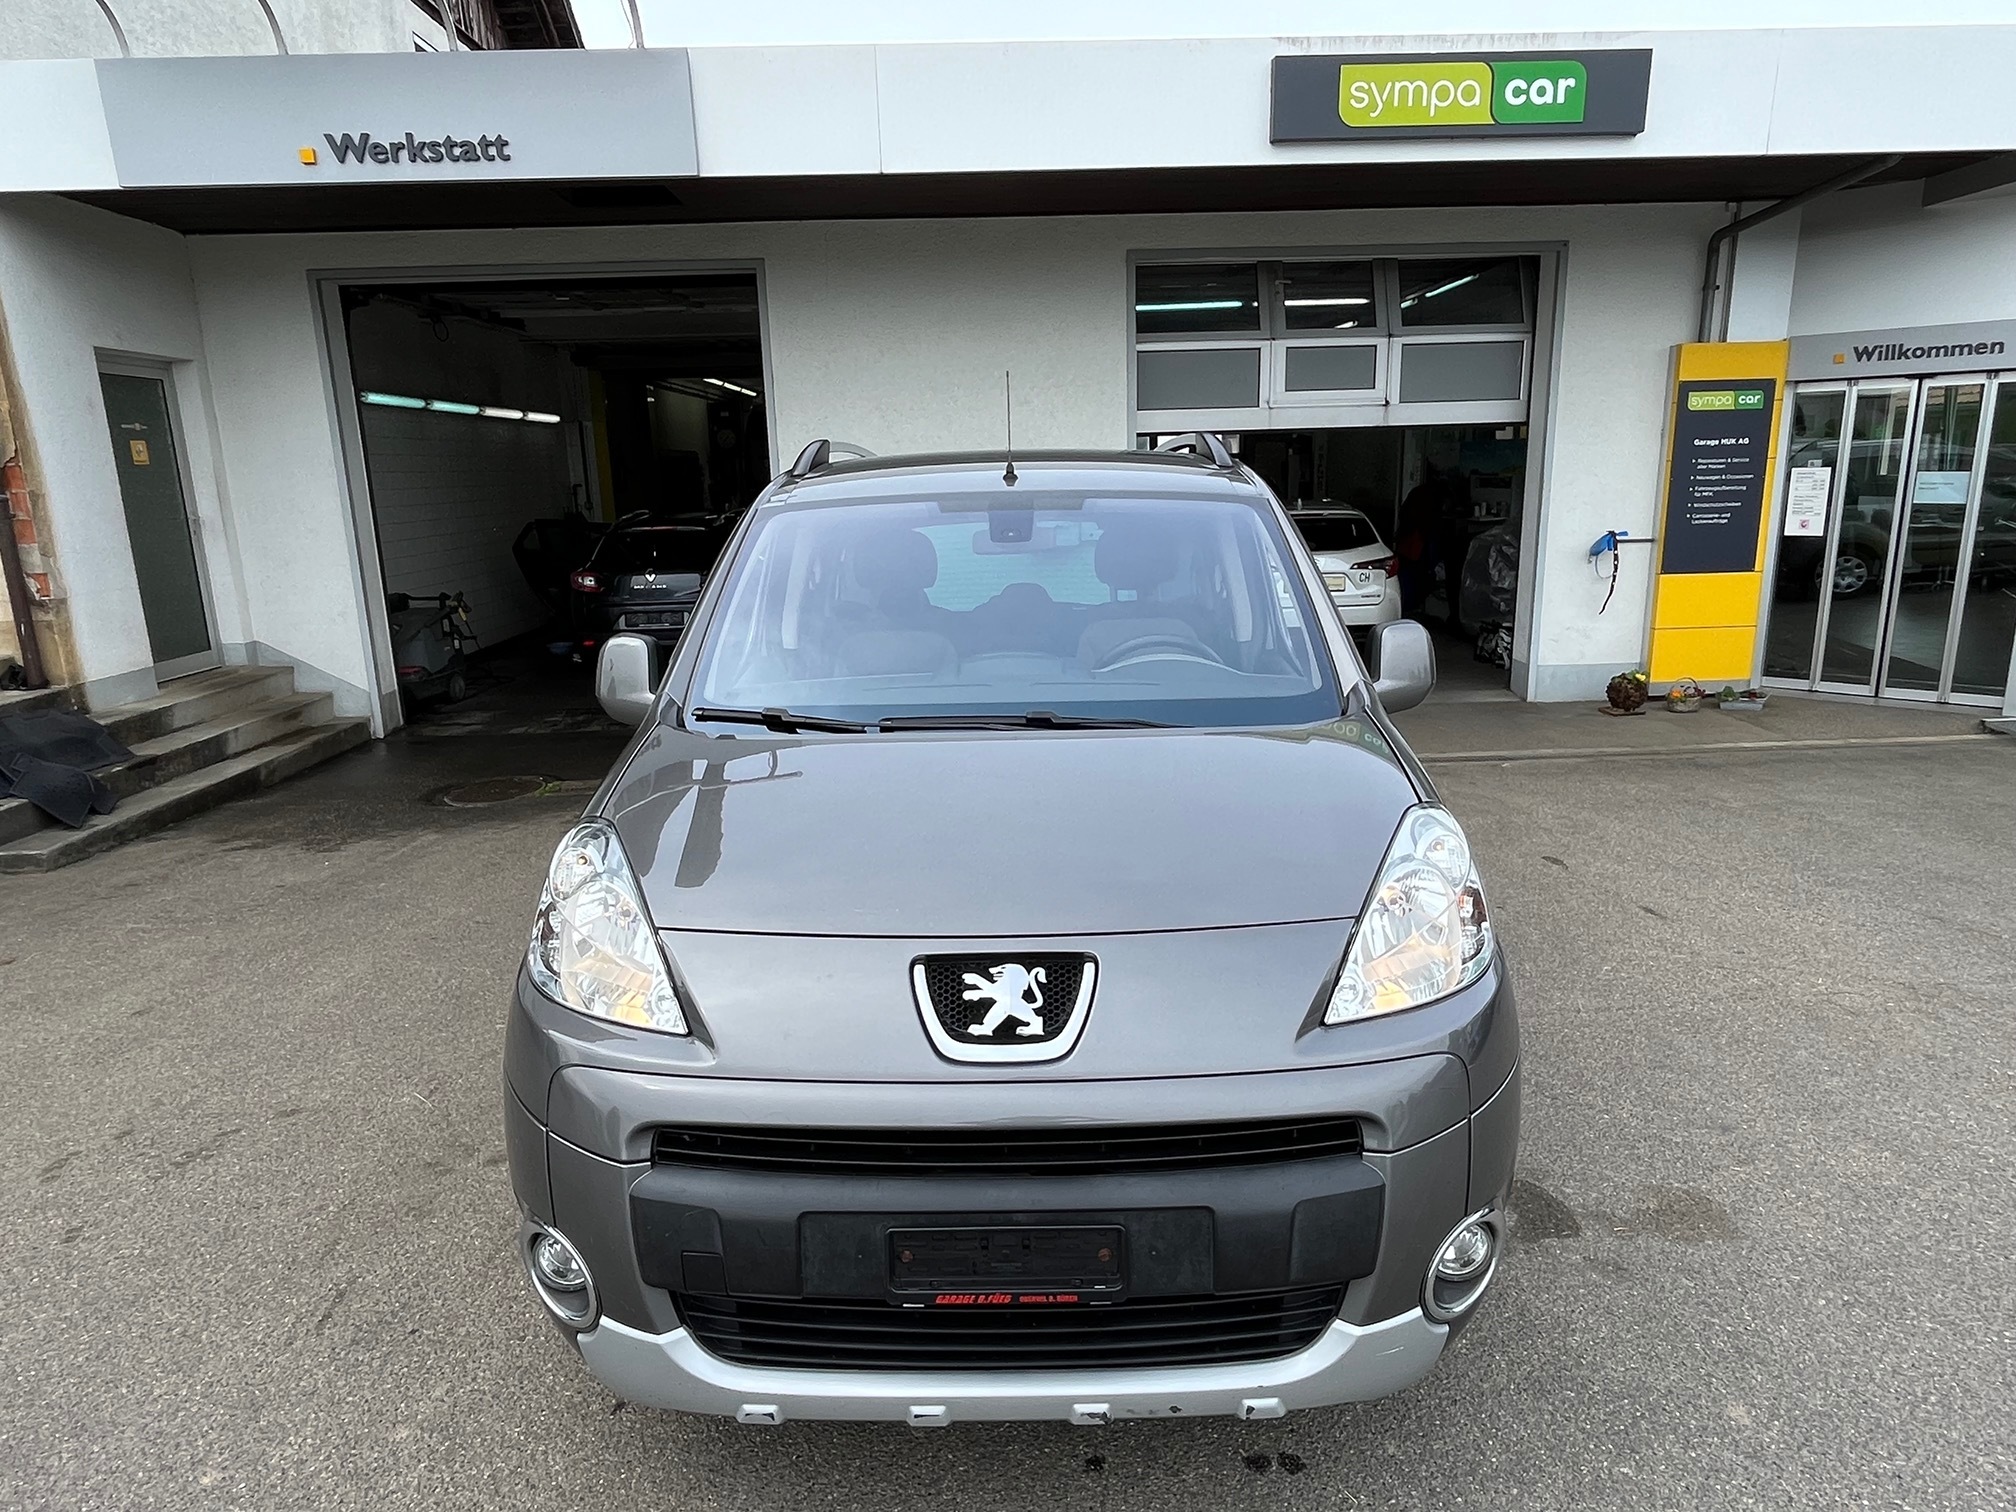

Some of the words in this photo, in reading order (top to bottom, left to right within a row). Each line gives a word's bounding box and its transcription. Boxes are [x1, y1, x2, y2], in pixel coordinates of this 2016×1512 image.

[1349, 79, 1482, 118] sympa
[1504, 76, 1576, 106] car
[323, 132, 512, 164] Werkstatt
[1853, 340, 2005, 363] Willkommen
[1691, 395, 1732, 407] sympa
[1738, 394, 1761, 404] car
[1693, 438, 1719, 447] Garage
[1720, 437, 1737, 445] HUK
[1737, 437, 1750, 445] AG
[1359, 572, 1371, 583] CH
[935, 1294, 976, 1304] GARAGE
